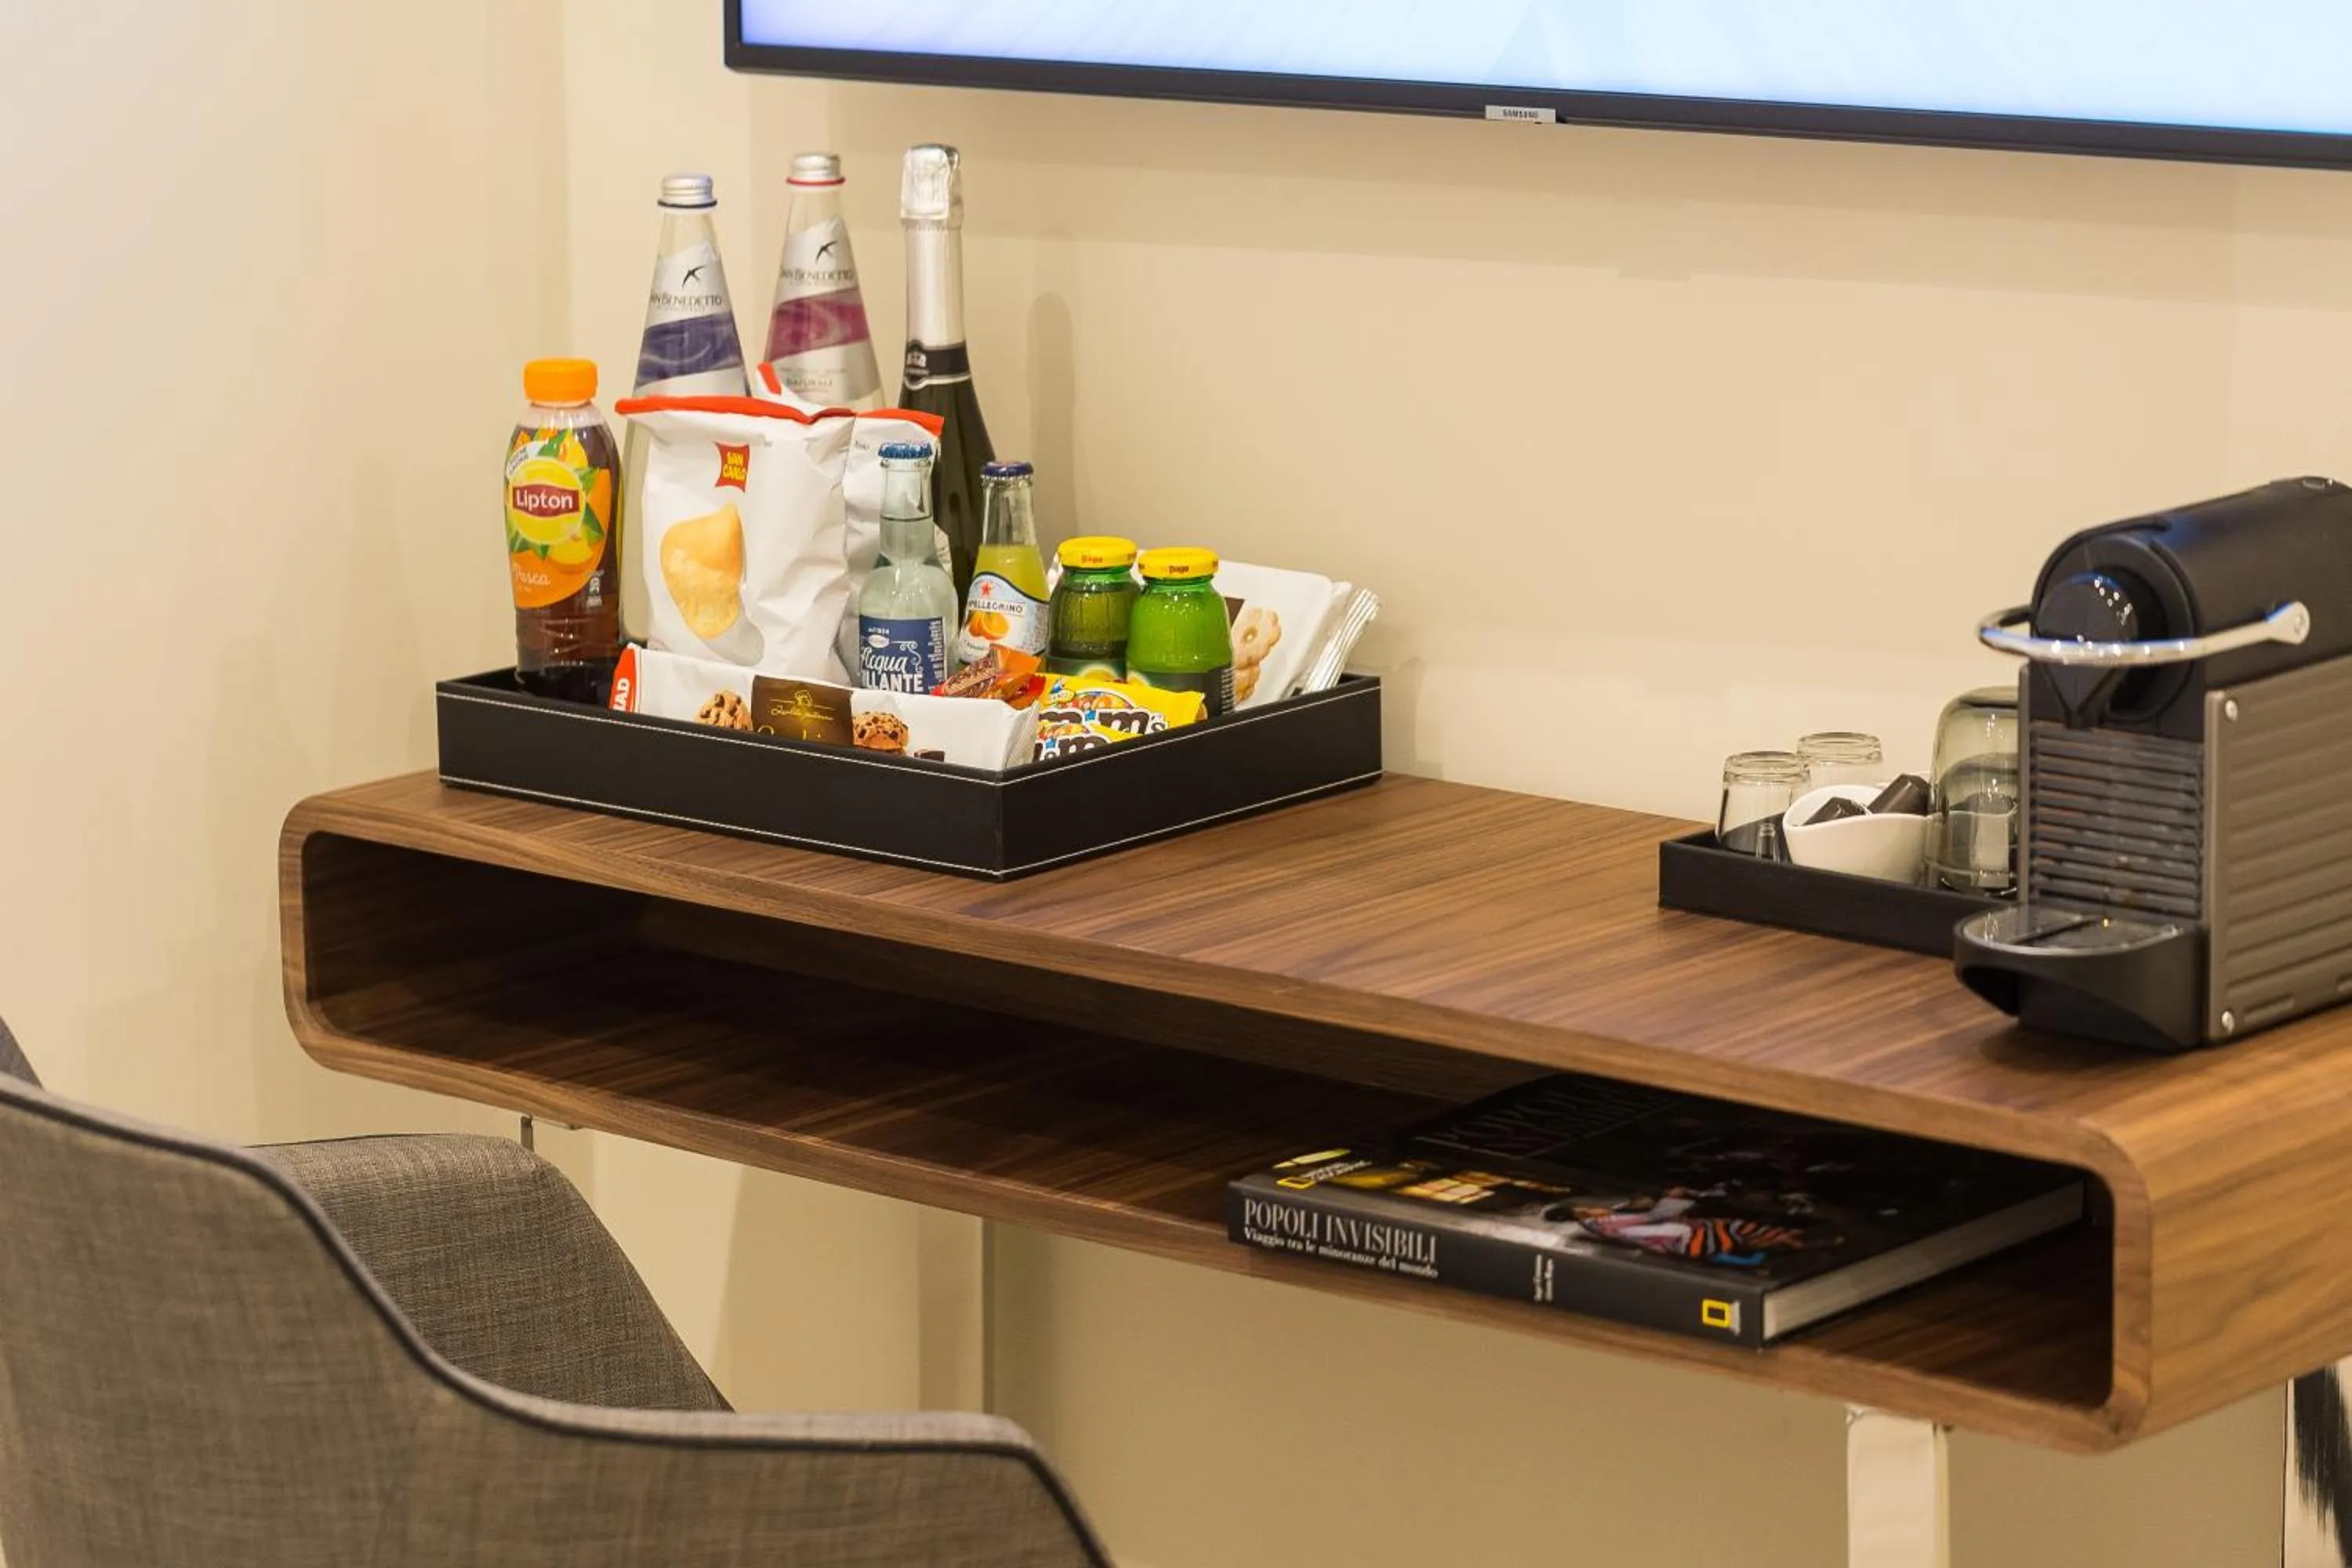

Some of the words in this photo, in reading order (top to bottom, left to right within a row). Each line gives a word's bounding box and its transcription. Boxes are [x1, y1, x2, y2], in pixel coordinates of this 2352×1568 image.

[726, 451, 744, 466] SAN
[516, 488, 573, 512] Lipton
[861, 646, 908, 675] Acqua
[1244, 1199, 1318, 1240] POPOLI
[1326, 1214, 1436, 1263] INVISIBILI
[1244, 1227, 1285, 1247] Viaggio
[1287, 1238, 1303, 1250] tra
[1306, 1240, 1316, 1253] le
[1377, 1256, 1396, 1271] del
[1399, 1261, 1439, 1279] mondo
